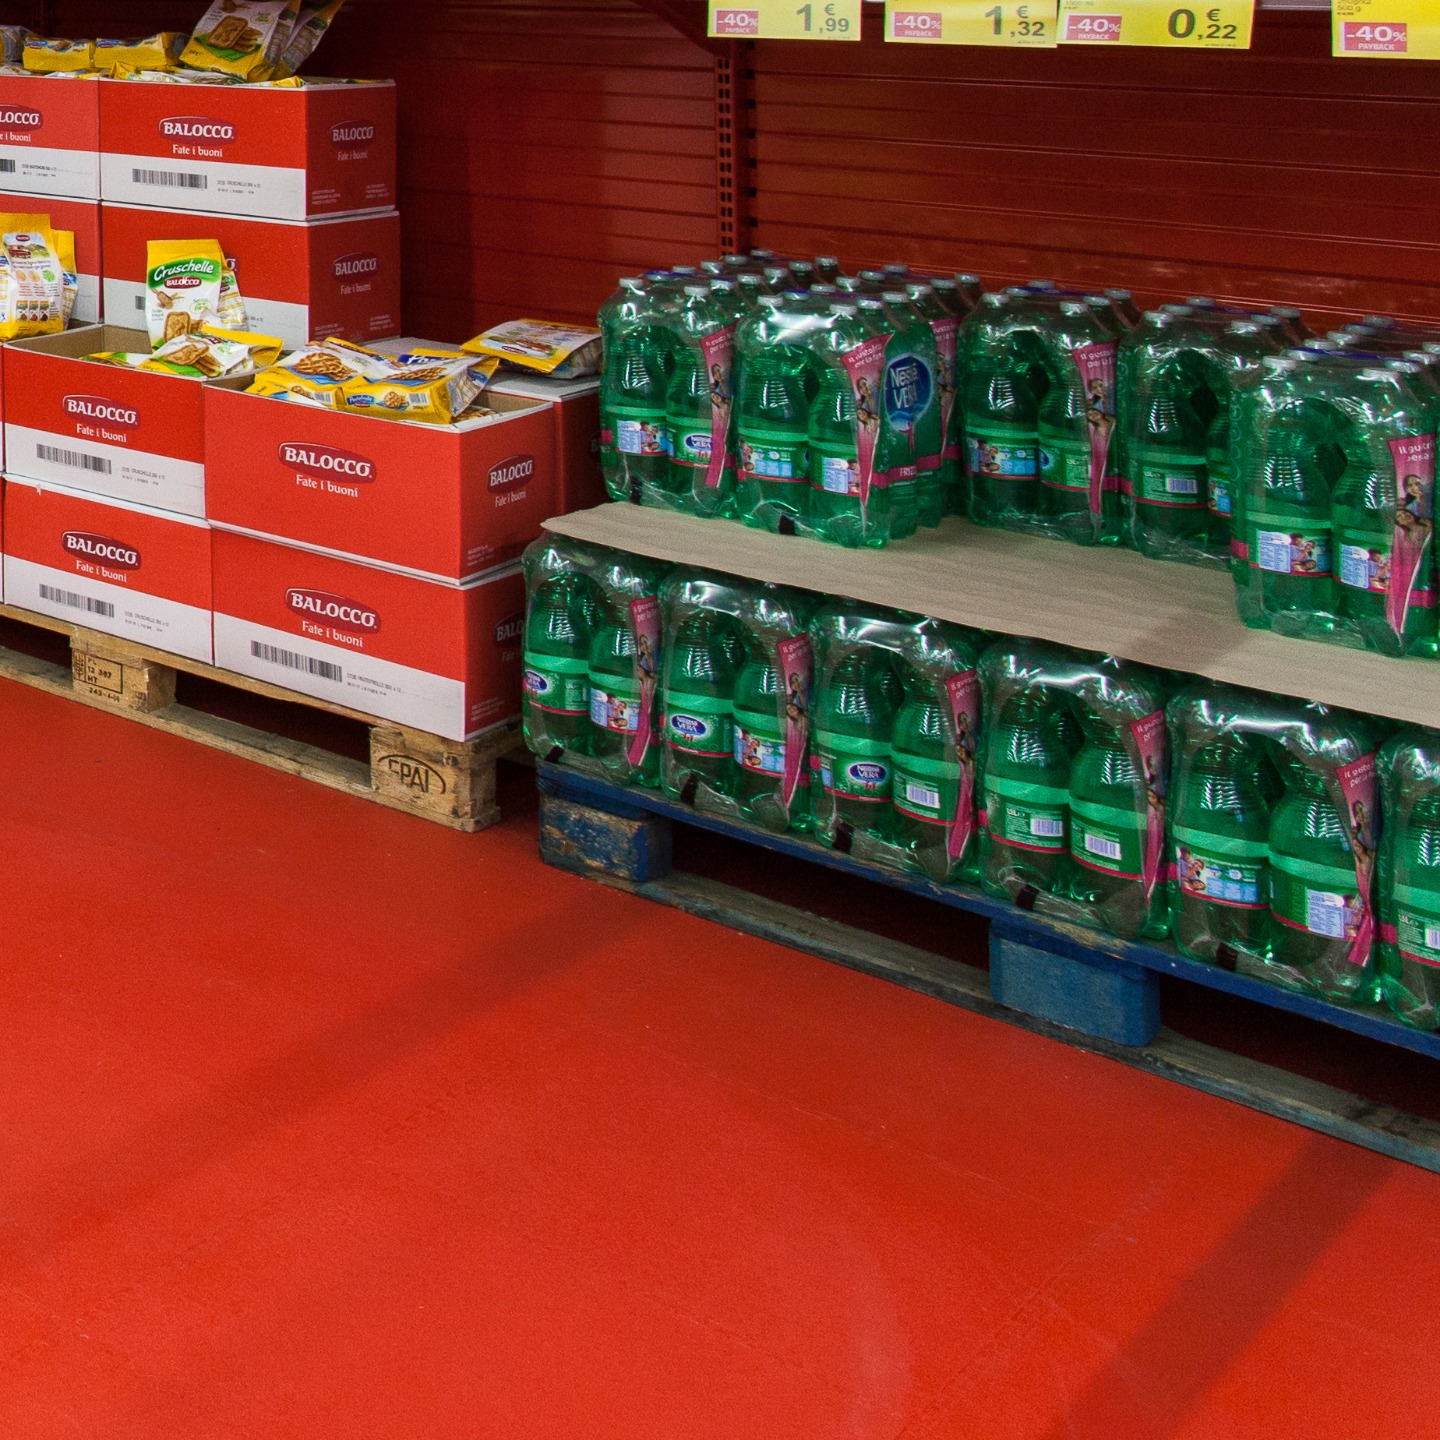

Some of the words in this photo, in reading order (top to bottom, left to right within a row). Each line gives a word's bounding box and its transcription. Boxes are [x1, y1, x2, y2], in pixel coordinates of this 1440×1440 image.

[154, 261, 215, 279] Cruschelle
[284, 446, 372, 479] BALOCCO
[295, 473, 318, 490] Fate
[327, 480, 358, 499] buoni
